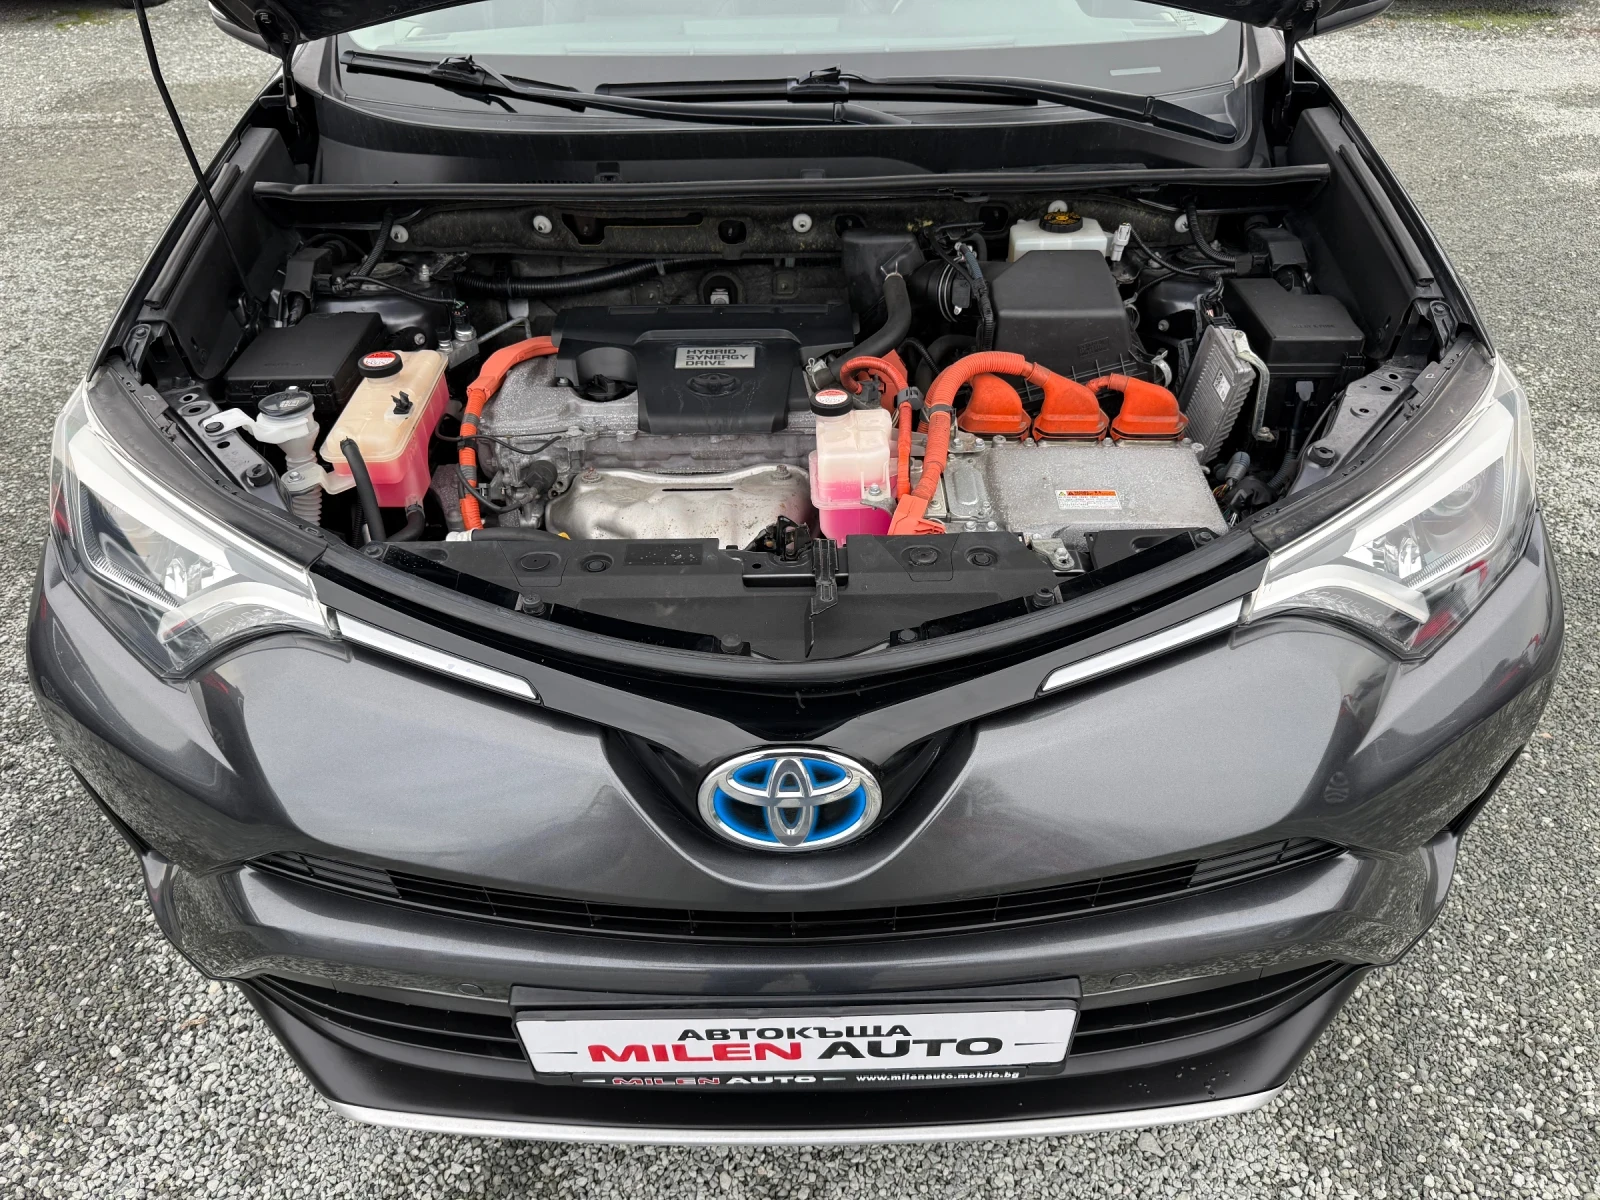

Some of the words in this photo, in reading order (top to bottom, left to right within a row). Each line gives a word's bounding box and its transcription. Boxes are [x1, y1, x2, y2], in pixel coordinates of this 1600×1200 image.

[588, 1042, 802, 1062] MILEN
[817, 1037, 1003, 1060] AUTO
[612, 1077, 720, 1085] MILEN
[726, 1076, 816, 1084] AUTO
[856, 1071, 1020, 1082] www.milenauto.mobile.bg
